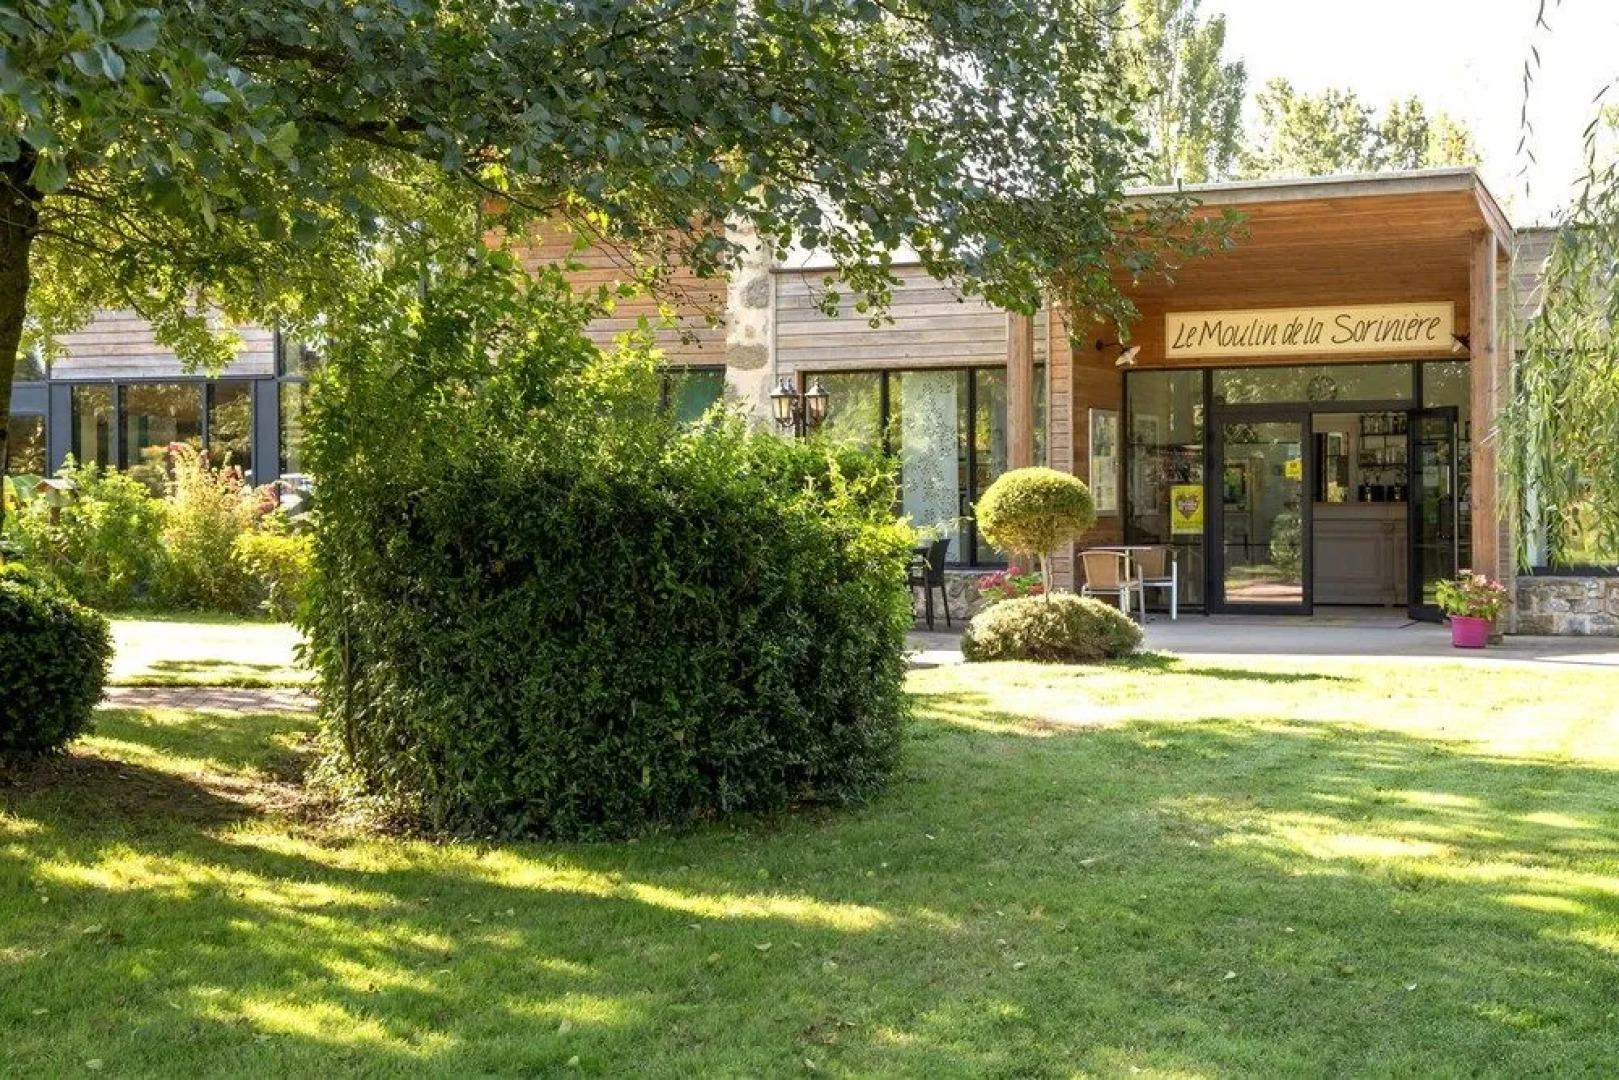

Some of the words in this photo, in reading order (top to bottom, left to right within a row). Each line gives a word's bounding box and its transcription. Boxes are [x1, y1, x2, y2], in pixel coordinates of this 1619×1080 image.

[1172, 322, 1197, 348] Le
[1198, 318, 1278, 347] Moulin
[1281, 316, 1303, 345] de
[1303, 317, 1324, 344] la
[1331, 313, 1441, 344] Sorinière
